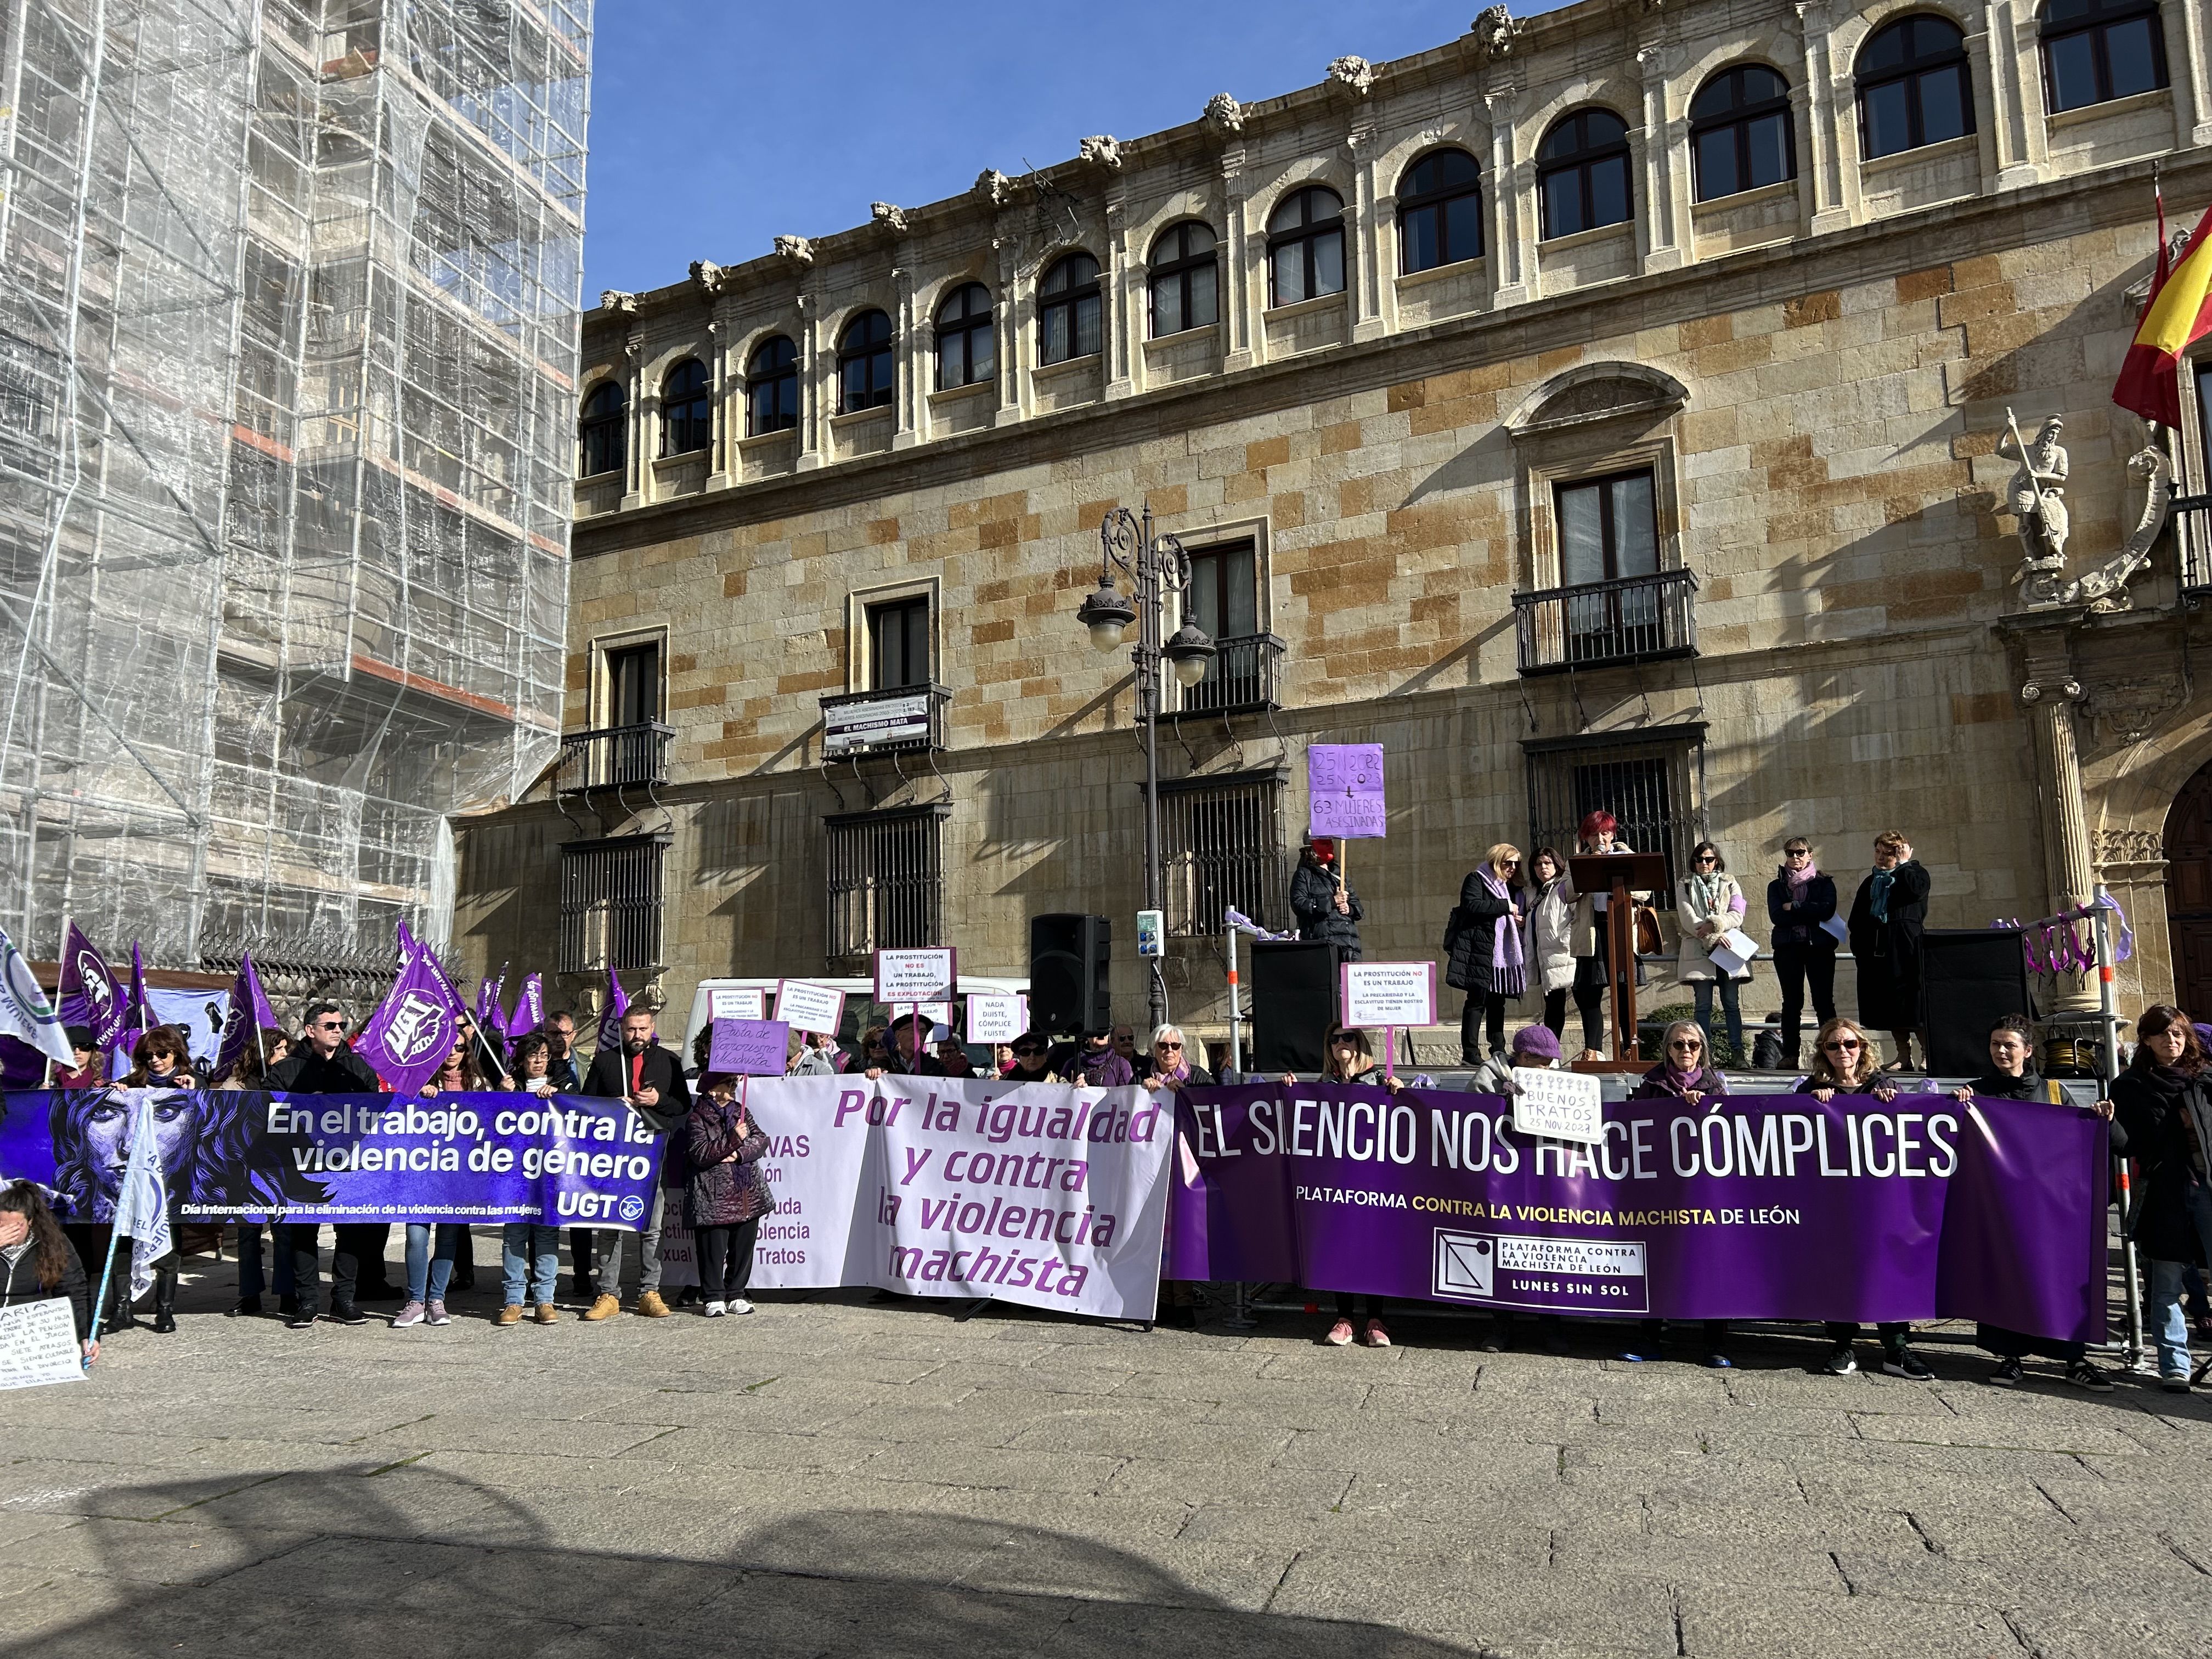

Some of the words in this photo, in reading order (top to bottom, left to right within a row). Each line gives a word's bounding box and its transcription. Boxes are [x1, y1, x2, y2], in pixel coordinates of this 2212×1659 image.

[853, 720, 888, 731] MACHISMO
[1351, 772, 1381, 784] 2023
[1313, 800, 1333, 814] 63
[1335, 799, 1383, 815] MUJERES
[1325, 815, 1385, 828] ASESINADAS
[715, 1019, 754, 1039] Basta
[755, 1024, 770, 1039] de
[715, 1051, 771, 1067] Machista
[1527, 1091, 1586, 1107] BUENOS
[834, 1090, 911, 1128] Por
[921, 1092, 961, 1132] la
[975, 1096, 1162, 1143] igualdad
[1525, 1104, 1592, 1121] TRATOS
[267, 1102, 313, 1133] En
[321, 1103, 351, 1135] el
[357, 1103, 484, 1142] trabajo,
[495, 1110, 617, 1141] contra
[624, 1112, 654, 1144] la
[1530, 1118, 1541, 1127] 25
[763, 1135, 810, 1158] VAS
[1193, 1104, 1242, 1159] EL
[1249, 1098, 1416, 1165] SILENCIO
[1431, 1109, 1520, 1175] NOS
[1536, 1119, 1657, 1180] HACE
[1670, 1103, 1958, 1177] CÓMPLICES
[292, 1139, 459, 1171] violencia
[468, 1141, 514, 1172] de
[522, 1141, 651, 1181] género
[900, 1146, 932, 1186] y
[944, 1151, 1088, 1192] contra
[181, 1204, 201, 1215] Día
[202, 1204, 276, 1215] Internacional
[278, 1206, 304, 1216] para
[304, 1205, 315, 1215] la
[316, 1204, 380, 1215] eliminación
[381, 1204, 396, 1215] de
[397, 1205, 407, 1215] la
[408, 1204, 454, 1215] violencia
[454, 1205, 486, 1216] contra
[487, 1205, 504, 1216] las
[505, 1204, 542, 1216] mujeres
[557, 1192, 618, 1218] UGT
[1295, 1186, 1407, 1209] PLATAFORMA
[1412, 1195, 1486, 1218] CONTRA
[1490, 1204, 1511, 1220] LA
[1516, 1205, 1615, 1226] VIOLENCIA
[1619, 1209, 1716, 1226] MACHISTA
[1720, 1209, 1744, 1224] DE
[1751, 1205, 1801, 1225] LEÓN
[878, 1186, 902, 1227] la
[921, 1193, 1116, 1248] violencia
[756, 1247, 806, 1265] Tratos
[1502, 1242, 1581, 1255] PLATAFORMA
[1587, 1247, 1637, 1257] CONTRA
[1502, 1251, 1516, 1260] LA
[1522, 1252, 1587, 1263] VIOLENCIA
[888, 1245, 1089, 1297] machista
[1502, 1260, 1564, 1271] MACHISTA
[1570, 1263, 1583, 1272] DE
[1590, 1263, 1622, 1274] LEÓN
[1513, 1279, 1560, 1293] LUNES
[1566, 1283, 1593, 1295] SIN
[1600, 1285, 1629, 1296] SOL
[27, 1305, 69, 1319] ESPERANDO
[12, 1346, 32, 1356] SIETE
[38, 1358, 71, 1369] DIVORCIO
